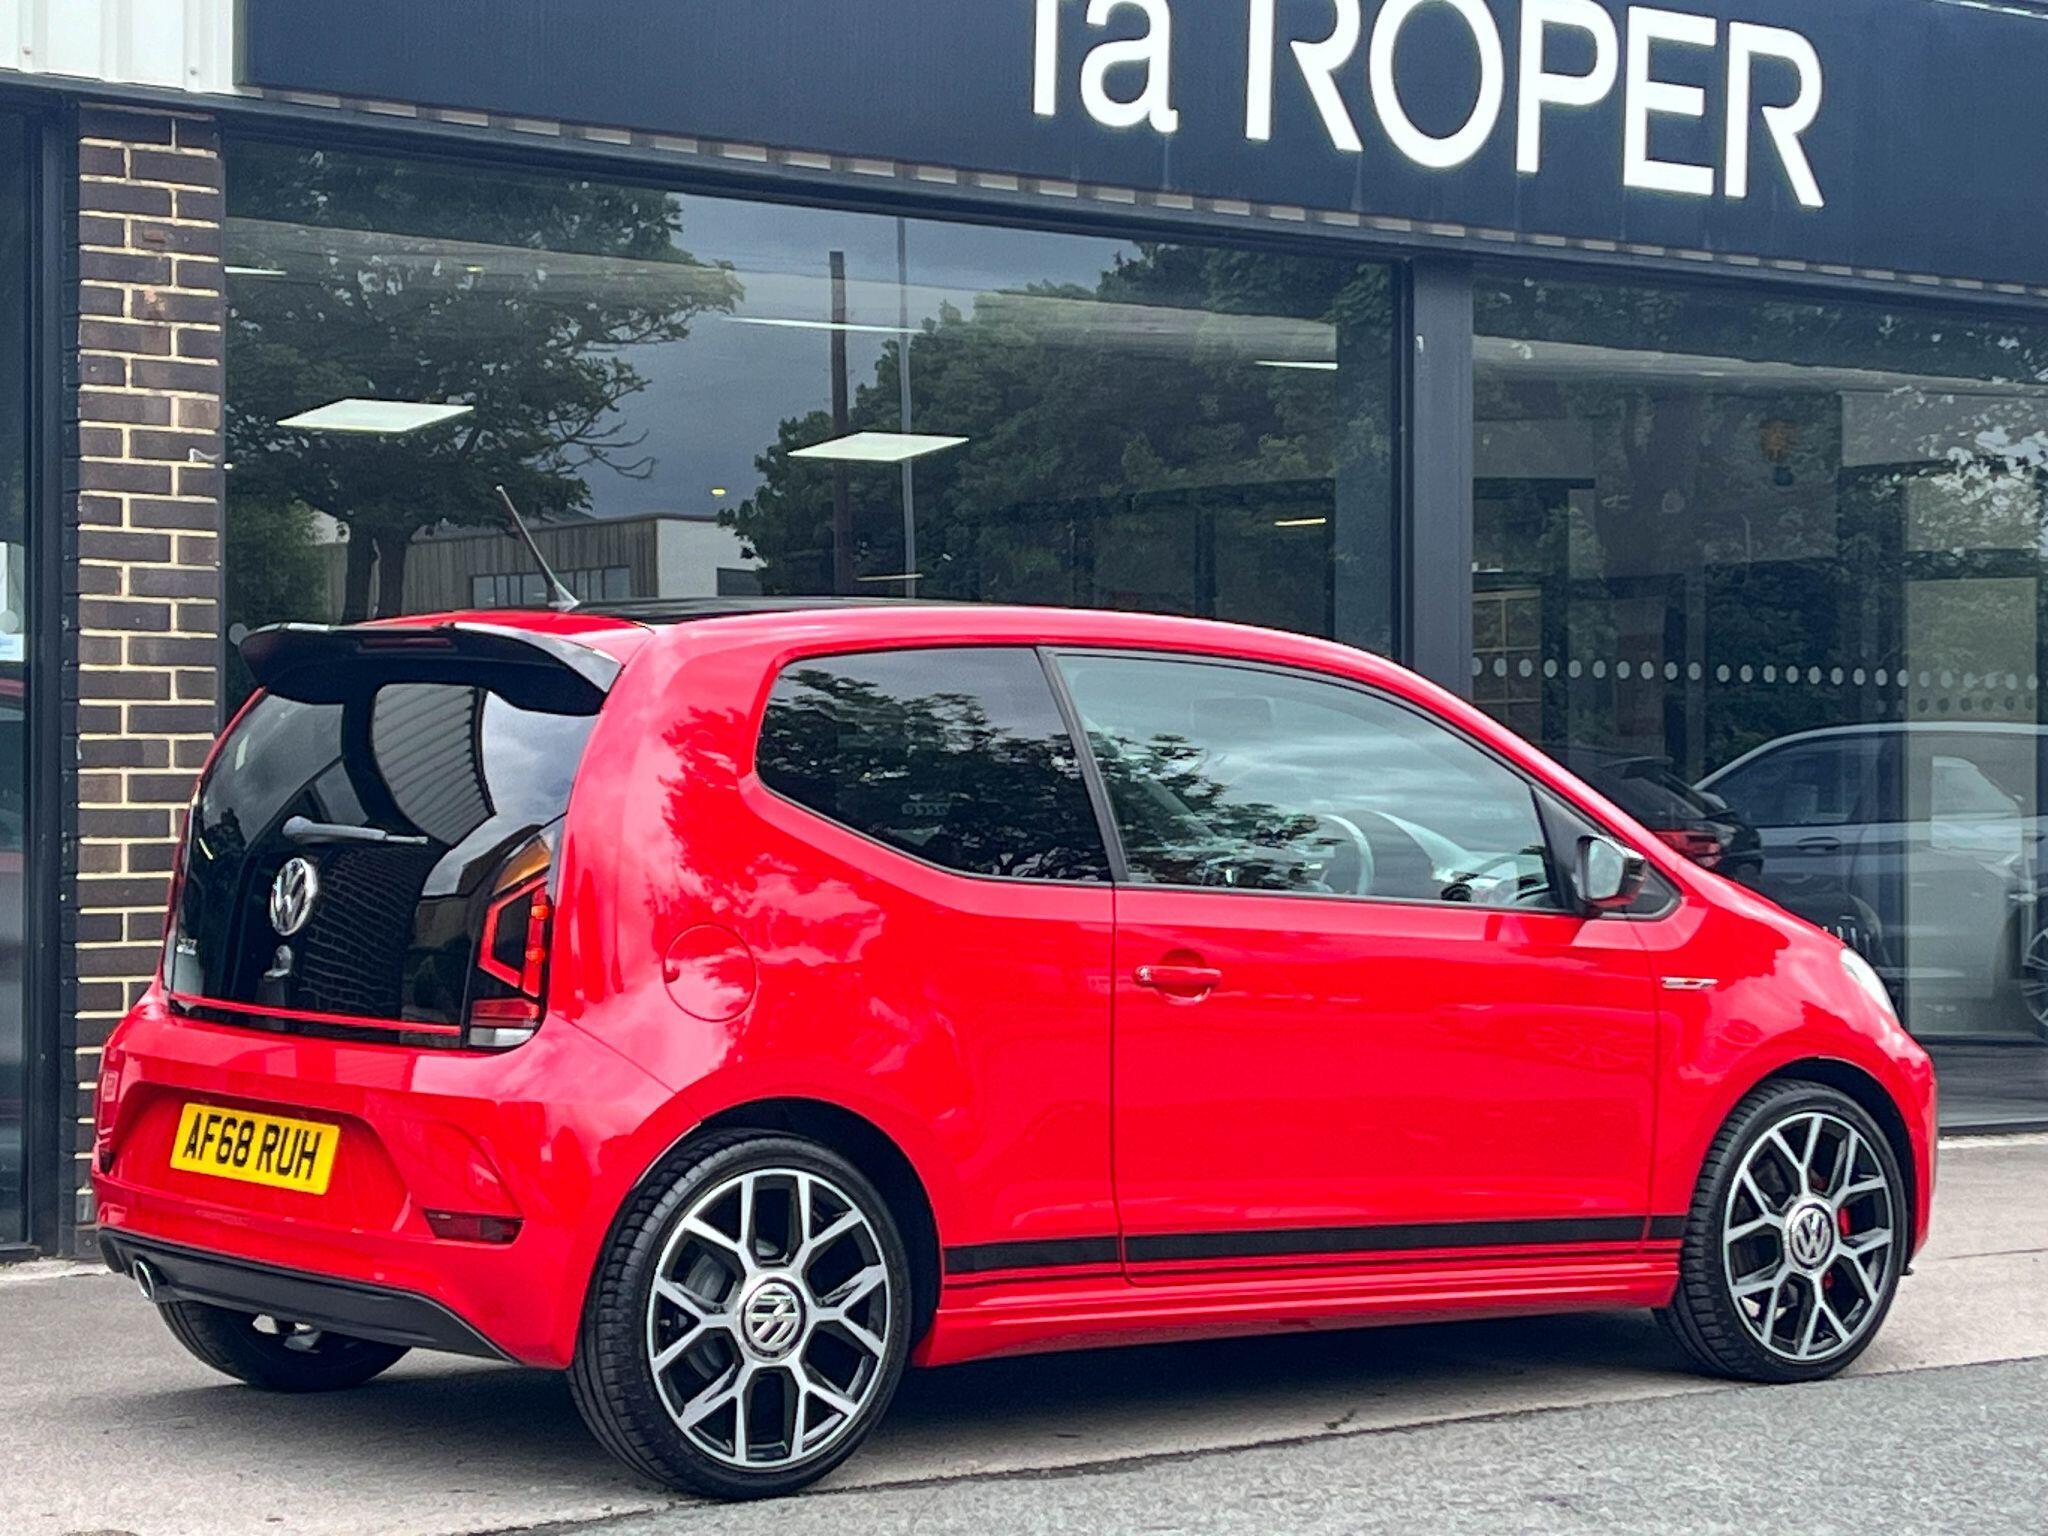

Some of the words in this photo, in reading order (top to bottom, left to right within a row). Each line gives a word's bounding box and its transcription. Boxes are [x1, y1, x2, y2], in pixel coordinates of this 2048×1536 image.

[1246, 0, 1824, 207] ROPER
[182, 1111, 255, 1168] AF68
[255, 1122, 322, 1181] RUH
